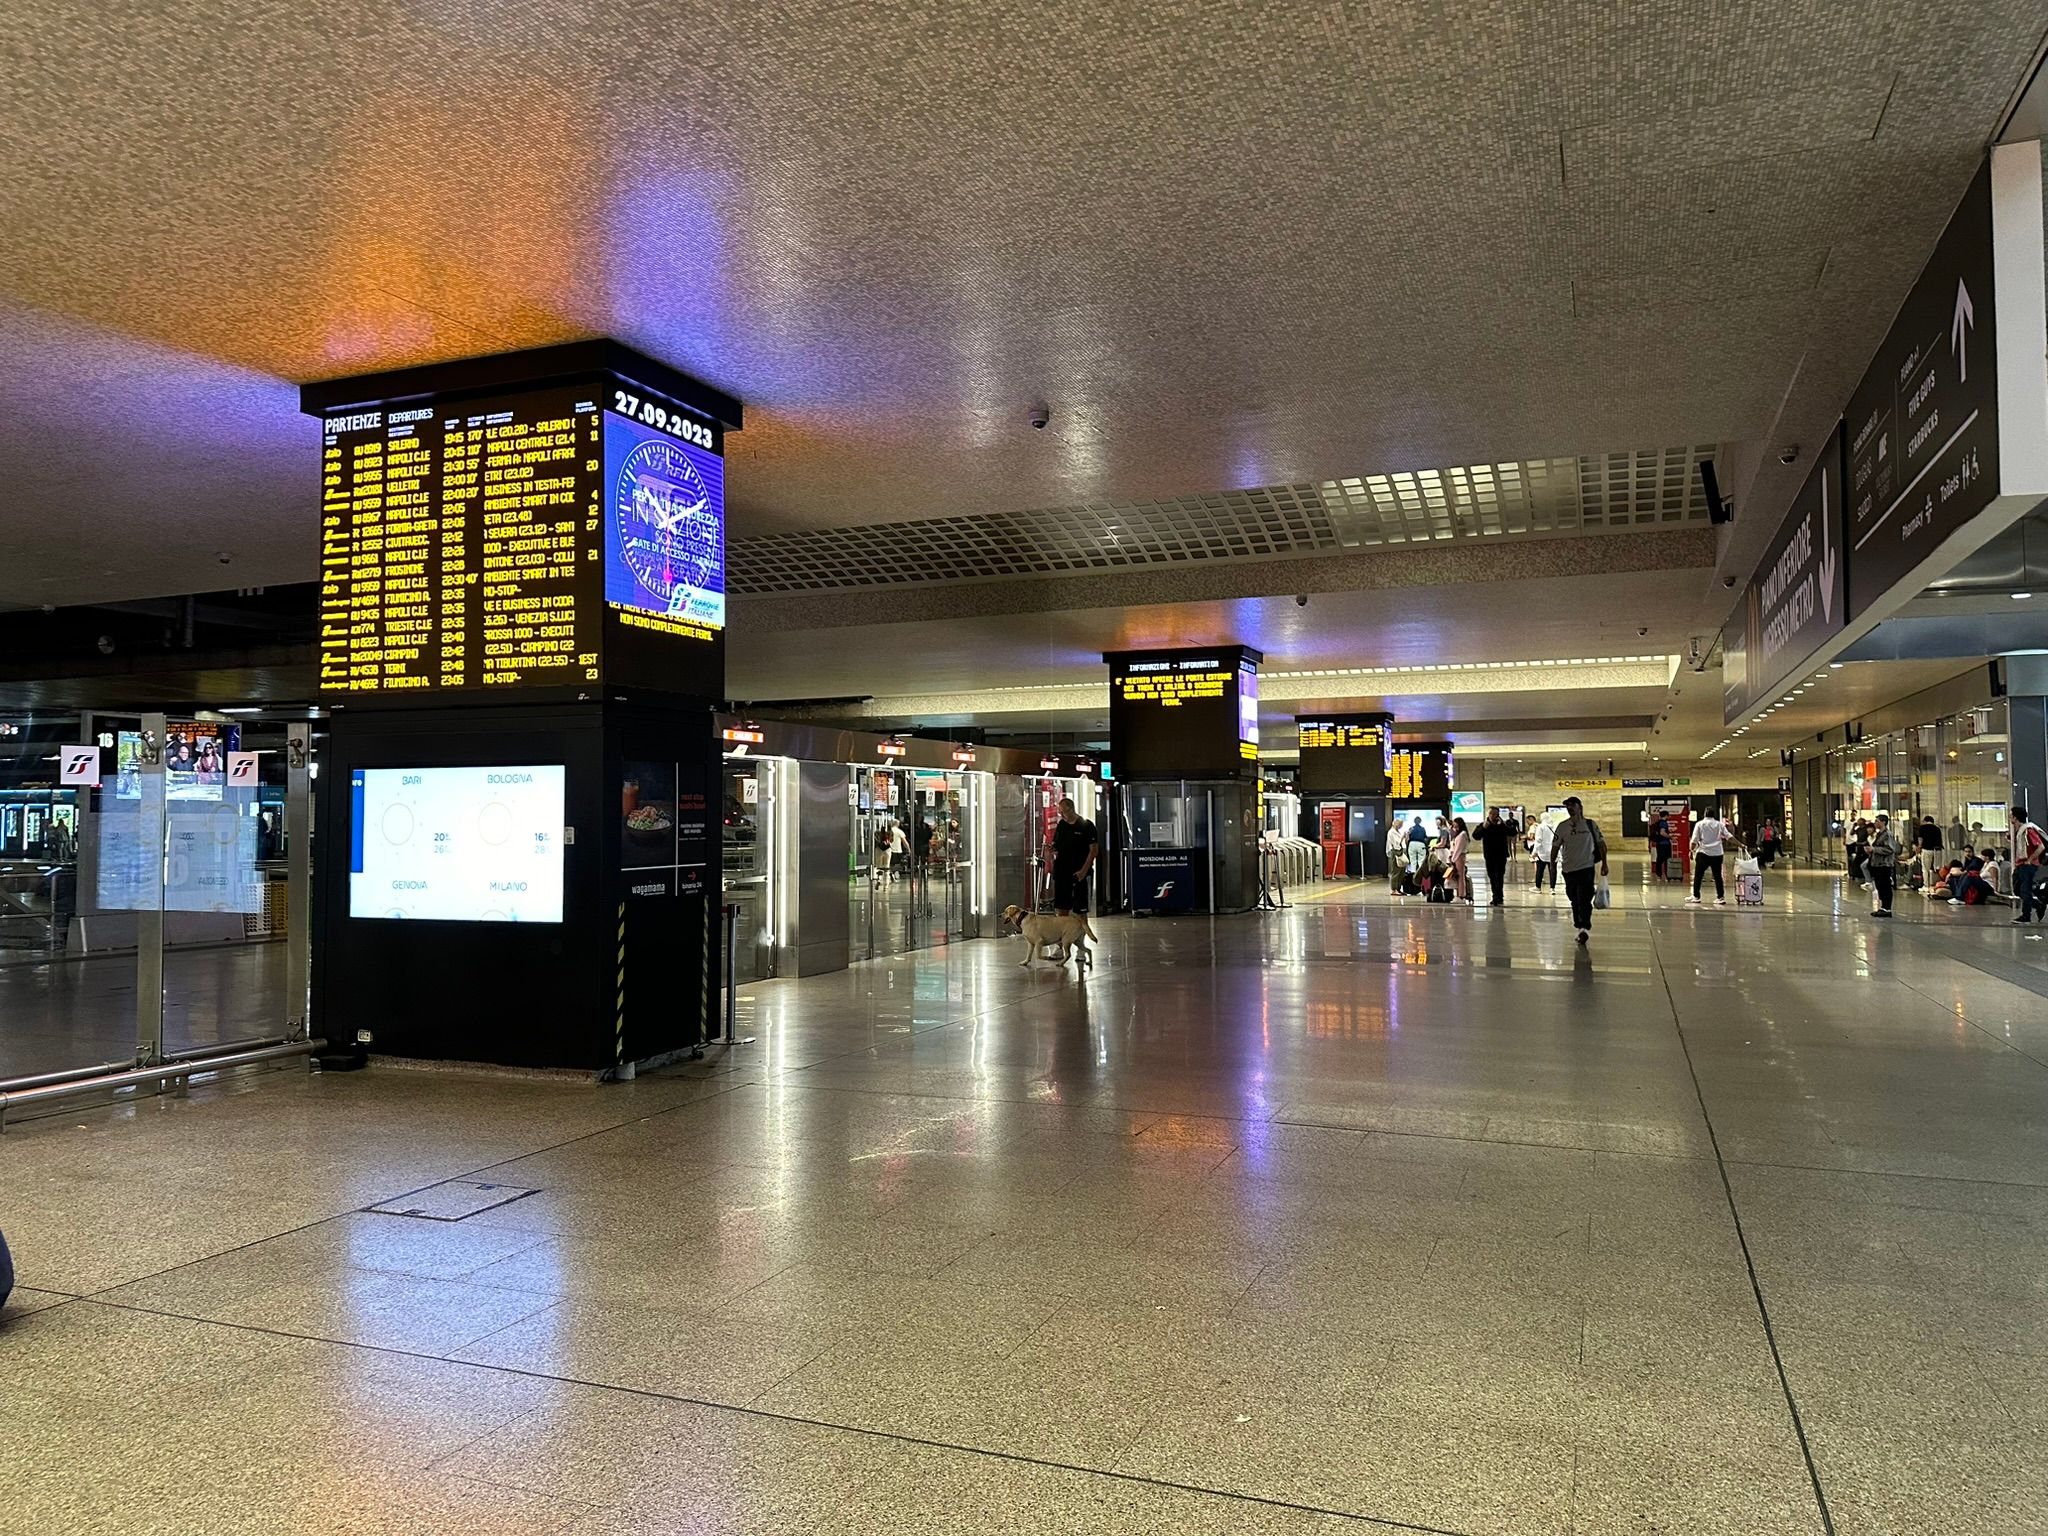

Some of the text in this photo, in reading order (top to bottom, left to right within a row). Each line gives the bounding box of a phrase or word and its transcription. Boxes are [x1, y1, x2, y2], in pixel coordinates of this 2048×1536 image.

[1908, 369, 1936, 418] FIVE GUYS
[325, 412, 381, 433] PARTENZE
[388, 408, 433, 424] DEPARTURES
[591, 415, 598, 426] 5
[614, 390, 712, 448] 27.09.2023
[590, 430, 597, 441] 11
[1908, 408, 1938, 458] STARBUCKS
[586, 460, 598, 471] 20
[1940, 475, 1959, 502] Toilets
[591, 490, 597, 500] 4
[588, 504, 597, 515] 12
[586, 519, 597, 531] 27
[1902, 511, 1923, 540] Pharmacy
[652, 544, 659, 552] DI
[587, 549, 597, 560] 21
[1761, 512, 1811, 618] PIANO INFERIORE
[1790, 572, 1814, 635] METRO
[586, 669, 597, 679] 23
[98, 733, 113, 748] 16
[402, 774, 533, 785] BARI BOLOGNA
[392, 881, 527, 891] GENOVA MILANO
[632, 883, 665, 896] wagamama
